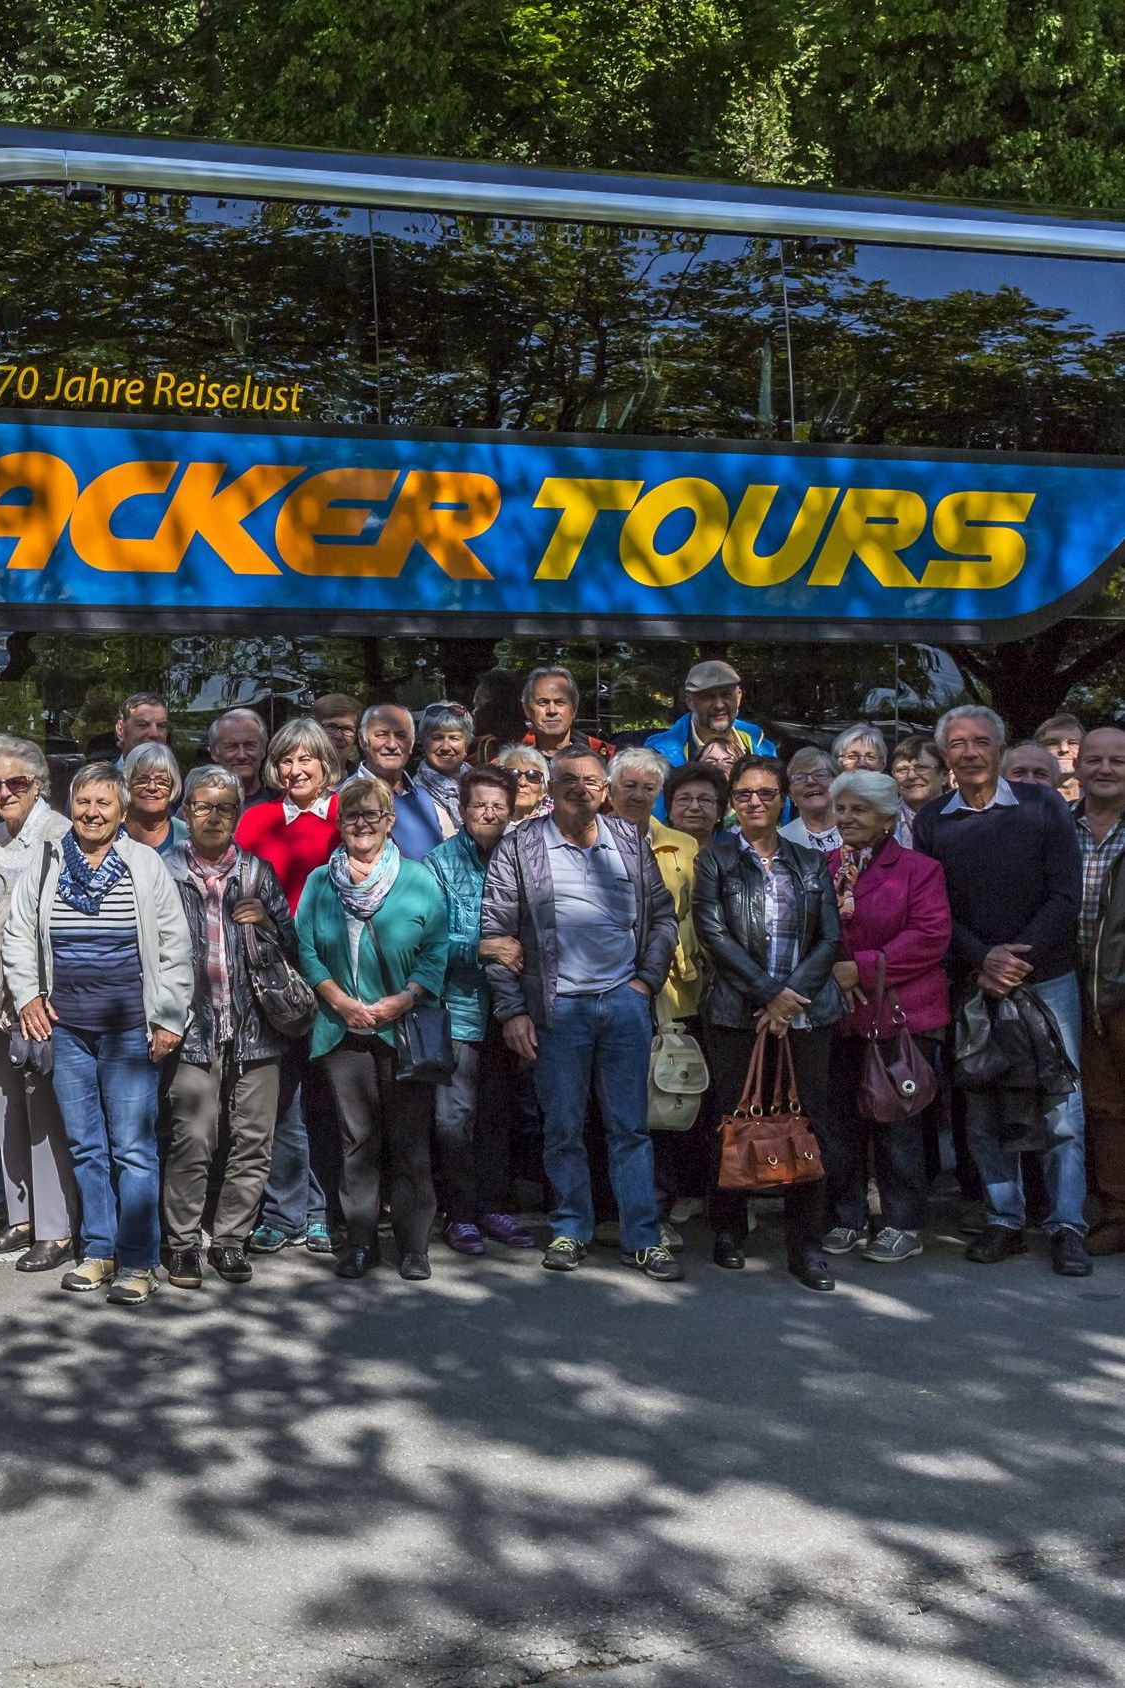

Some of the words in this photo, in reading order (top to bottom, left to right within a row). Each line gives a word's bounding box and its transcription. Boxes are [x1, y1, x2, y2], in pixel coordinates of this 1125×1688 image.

[44, 366, 146, 405] Jahre
[153, 371, 304, 412] Reiselust
[531, 476, 1037, 590] TOURS
